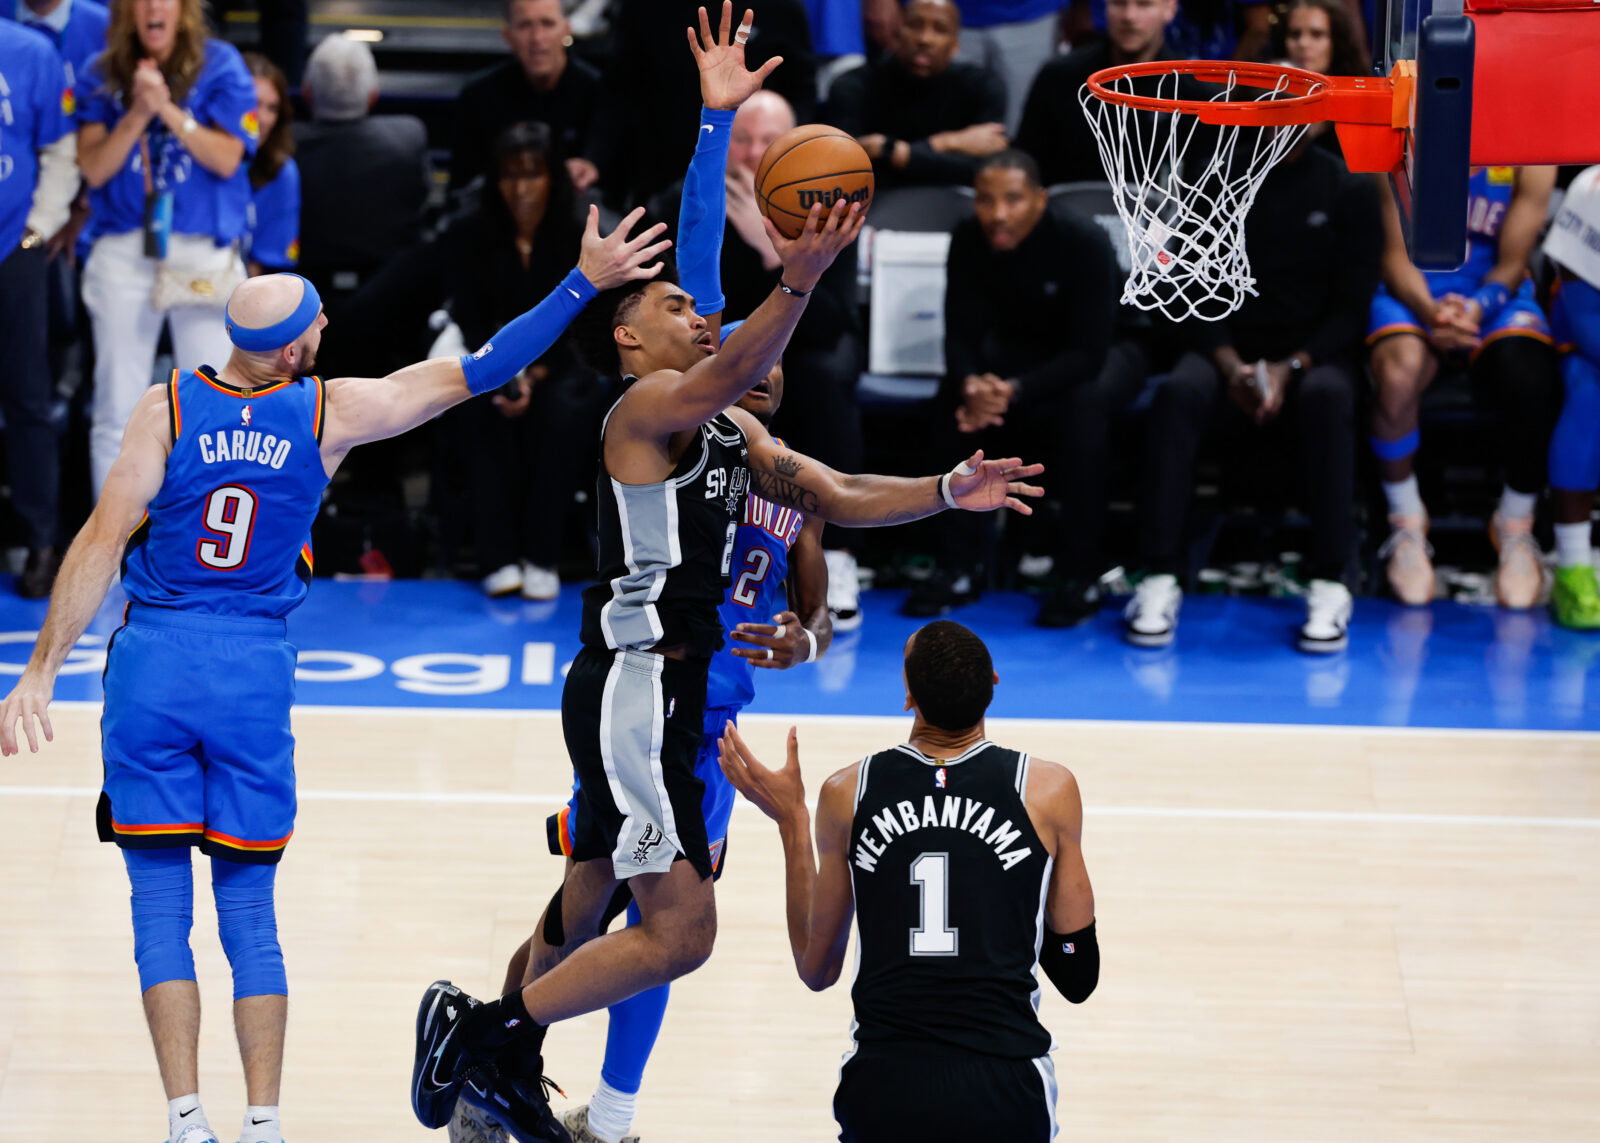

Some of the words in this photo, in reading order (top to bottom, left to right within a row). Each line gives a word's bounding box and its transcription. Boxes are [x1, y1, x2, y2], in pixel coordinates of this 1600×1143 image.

[797, 187, 869, 210] Wilson
[198, 429, 292, 470] CARUSO
[196, 483, 259, 572] 9
[731, 547, 773, 609] 2
[855, 795, 1033, 874] WEMBANYAMA
[909, 852, 959, 956] 1
